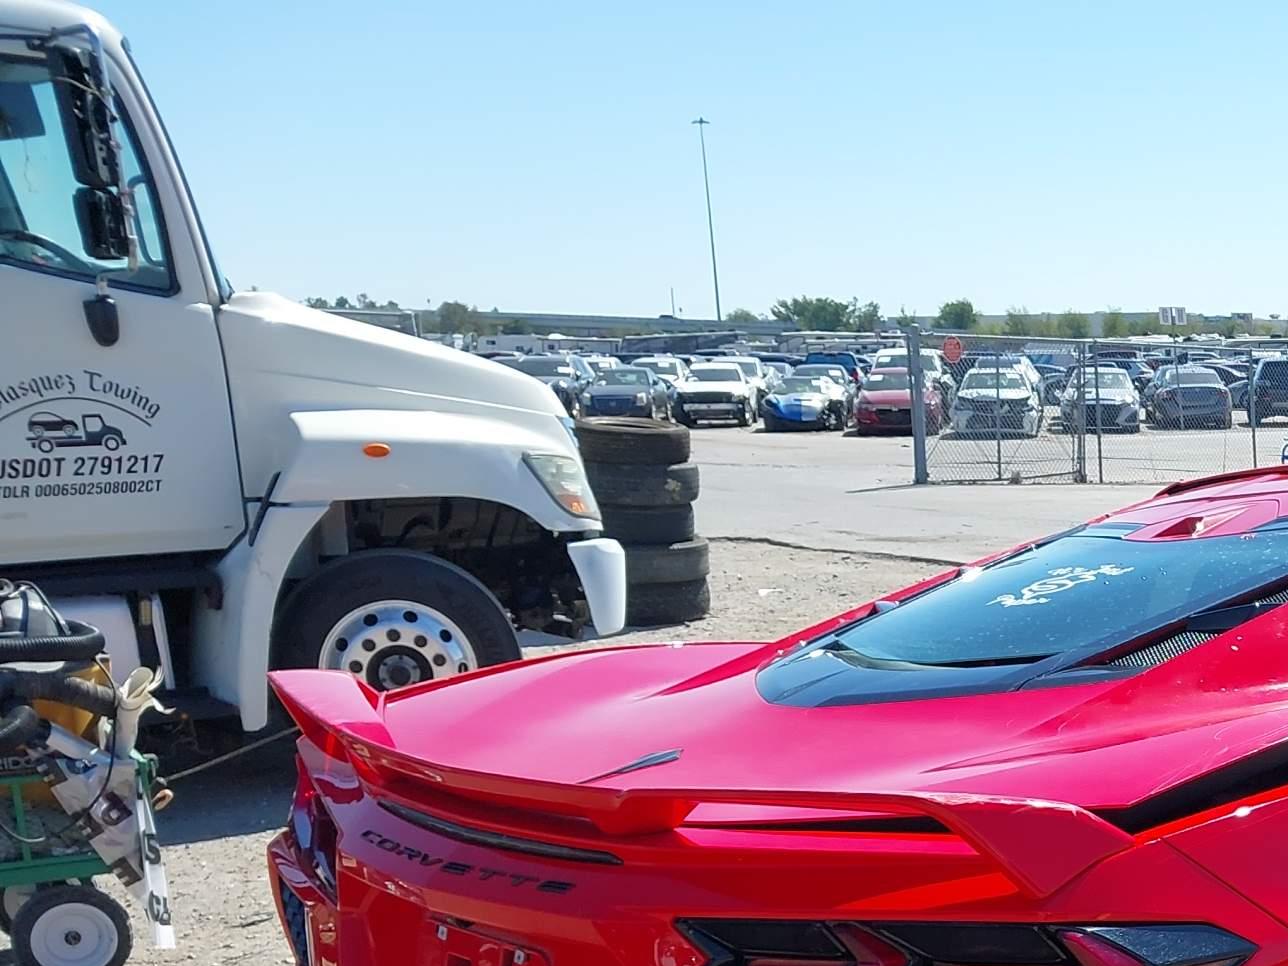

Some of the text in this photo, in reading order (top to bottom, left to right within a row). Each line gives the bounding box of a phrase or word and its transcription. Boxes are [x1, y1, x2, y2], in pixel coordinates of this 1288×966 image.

[83, 369, 160, 419] Towing
[73, 454, 164, 476] 2791217
[0, 479, 162, 499] DLR 0006502508002CT
[360, 829, 577, 895] CORVETTE
